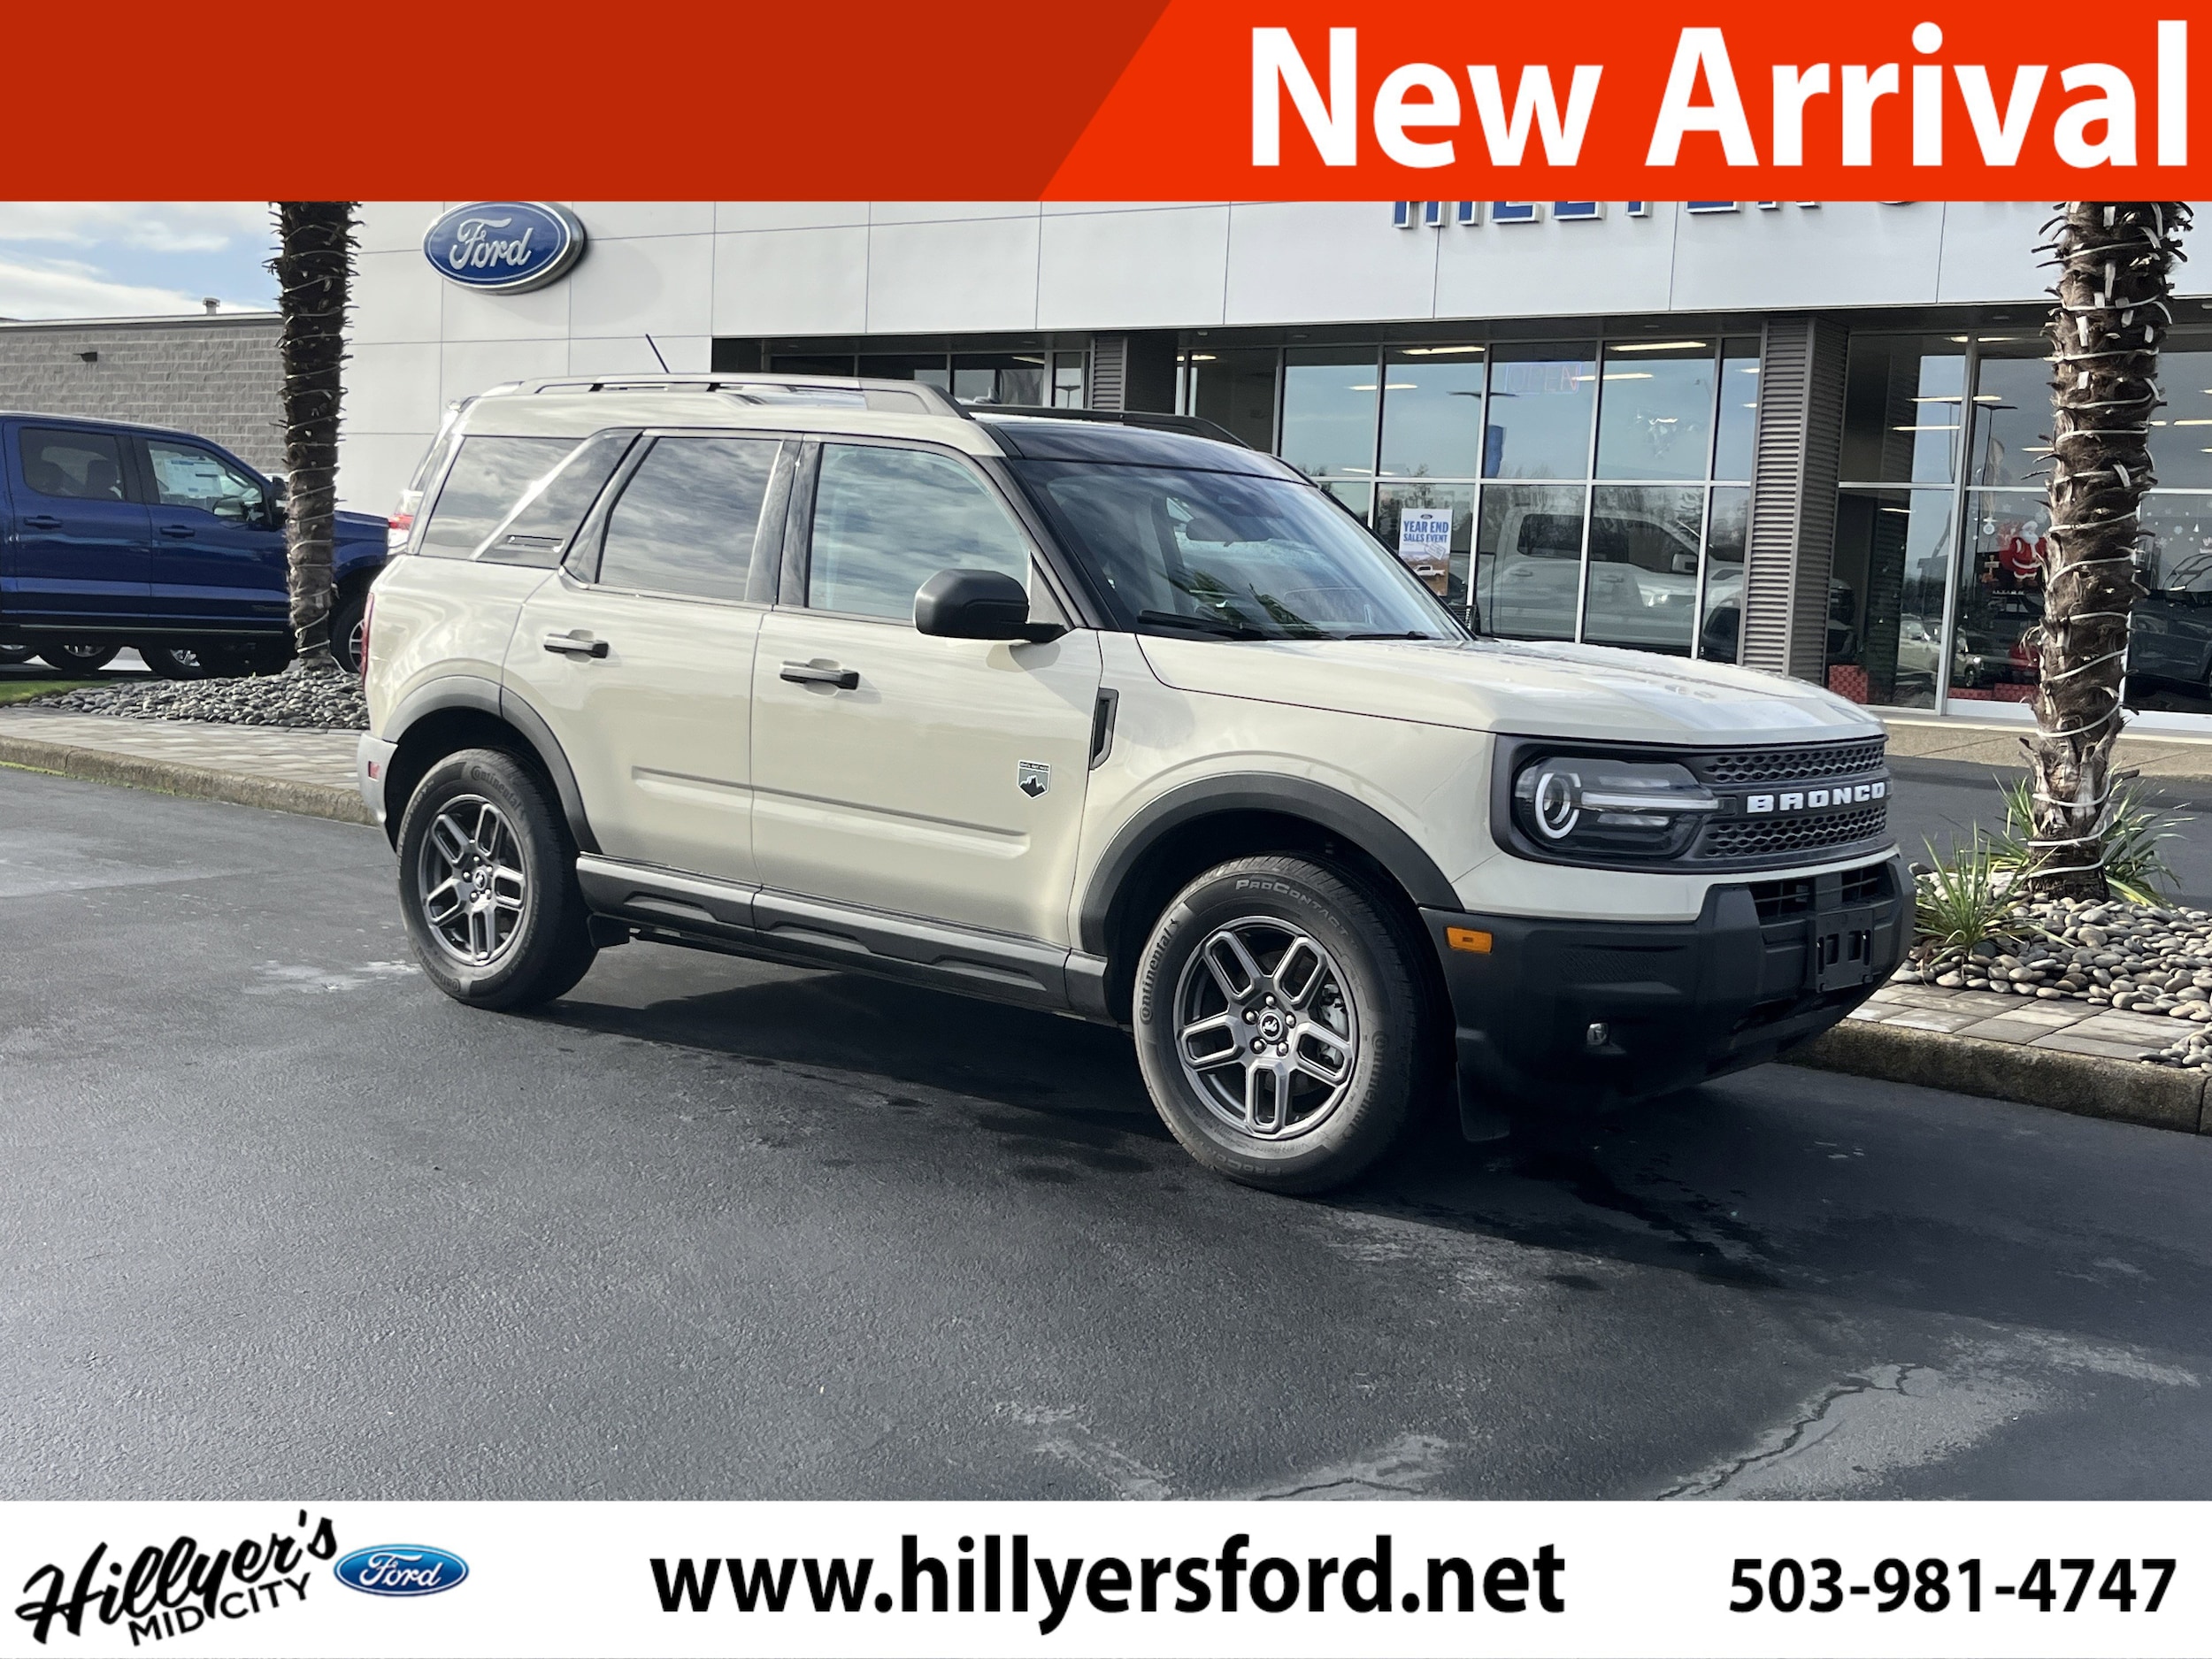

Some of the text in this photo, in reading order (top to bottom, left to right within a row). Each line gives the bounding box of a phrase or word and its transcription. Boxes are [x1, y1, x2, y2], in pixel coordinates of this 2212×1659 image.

[449, 218, 534, 270] Ford
[1509, 365, 1579, 392] OPEN
[1403, 520, 1449, 534] YEAR END
[1403, 533, 1448, 543] SALES EVENT
[471, 765, 522, 812] Continental
[1747, 782, 1886, 813] BRONCO
[1140, 927, 1173, 1025] Continental
